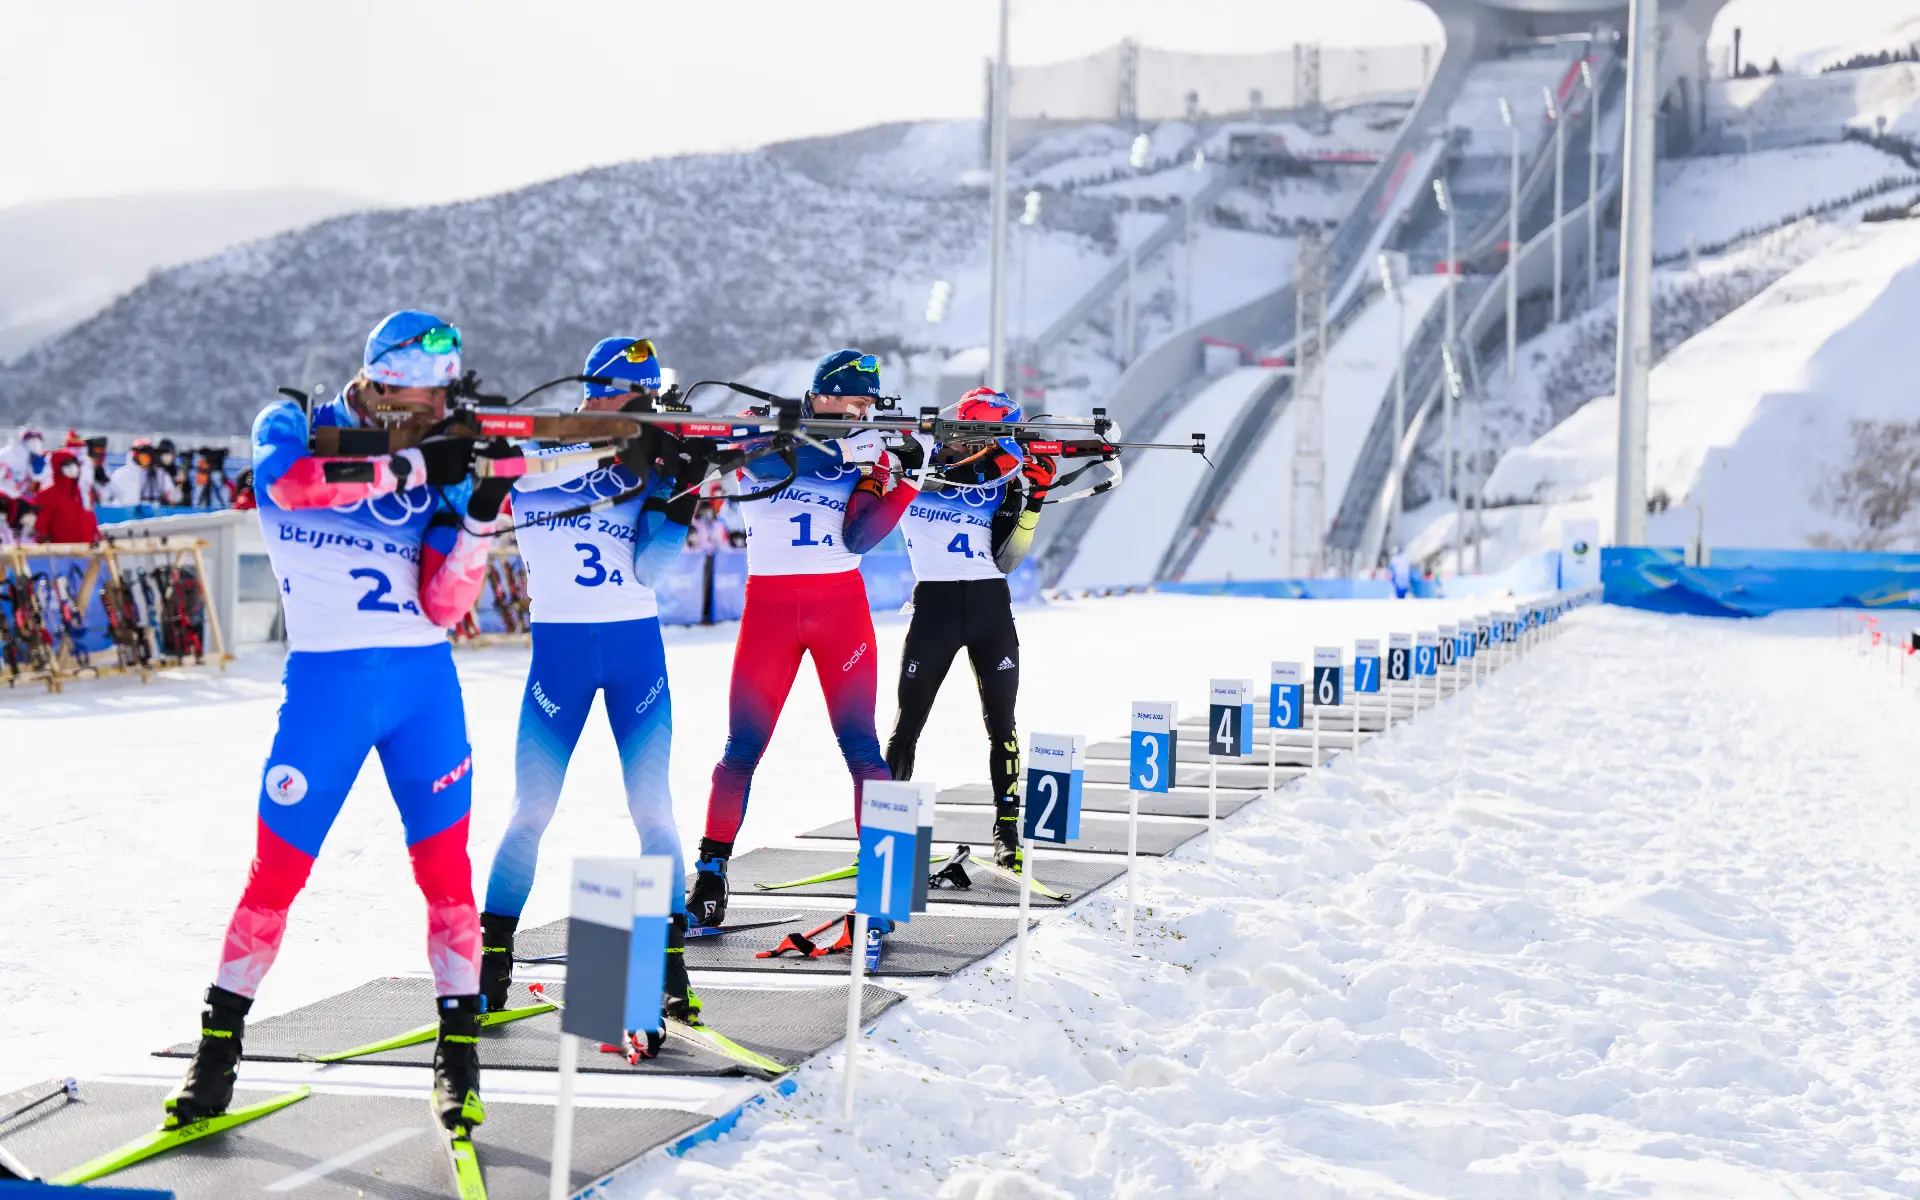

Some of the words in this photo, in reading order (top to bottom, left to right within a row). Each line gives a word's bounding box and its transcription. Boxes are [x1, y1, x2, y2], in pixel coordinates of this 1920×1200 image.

[817, 495, 848, 513] 202
[909, 505, 962, 524] BEIJING
[278, 523, 374, 550] BEIJING
[524, 511, 592, 532] BEIJING
[598, 519, 638, 543] 2022
[789, 512, 819, 547] 1
[822, 534, 834, 546] 4
[907, 538, 913, 549] 4
[947, 532, 974, 559] 4
[574, 542, 607, 588] 3
[609, 569, 624, 586] 4
[283, 577, 291, 595] 4
[348, 567, 401, 613] 2
[402, 600, 420, 616] 4
[1439, 637, 1454, 665] 10
[1459, 634, 1472, 657] 11
[1475, 626, 1488, 649] 12
[842, 642, 867, 672] odlo
[1392, 649, 1405, 680] 8
[1419, 647, 1431, 675] 9
[1318, 668, 1334, 705] 6
[1360, 658, 1372, 691] 7
[531, 681, 561, 718] FRANCE
[636, 676, 664, 714] odlo
[1276, 686, 1291, 727] 5
[1216, 708, 1234, 754] 4
[1139, 735, 1159, 789] 3
[1034, 774, 1059, 840] 2
[873, 835, 895, 914] 1
